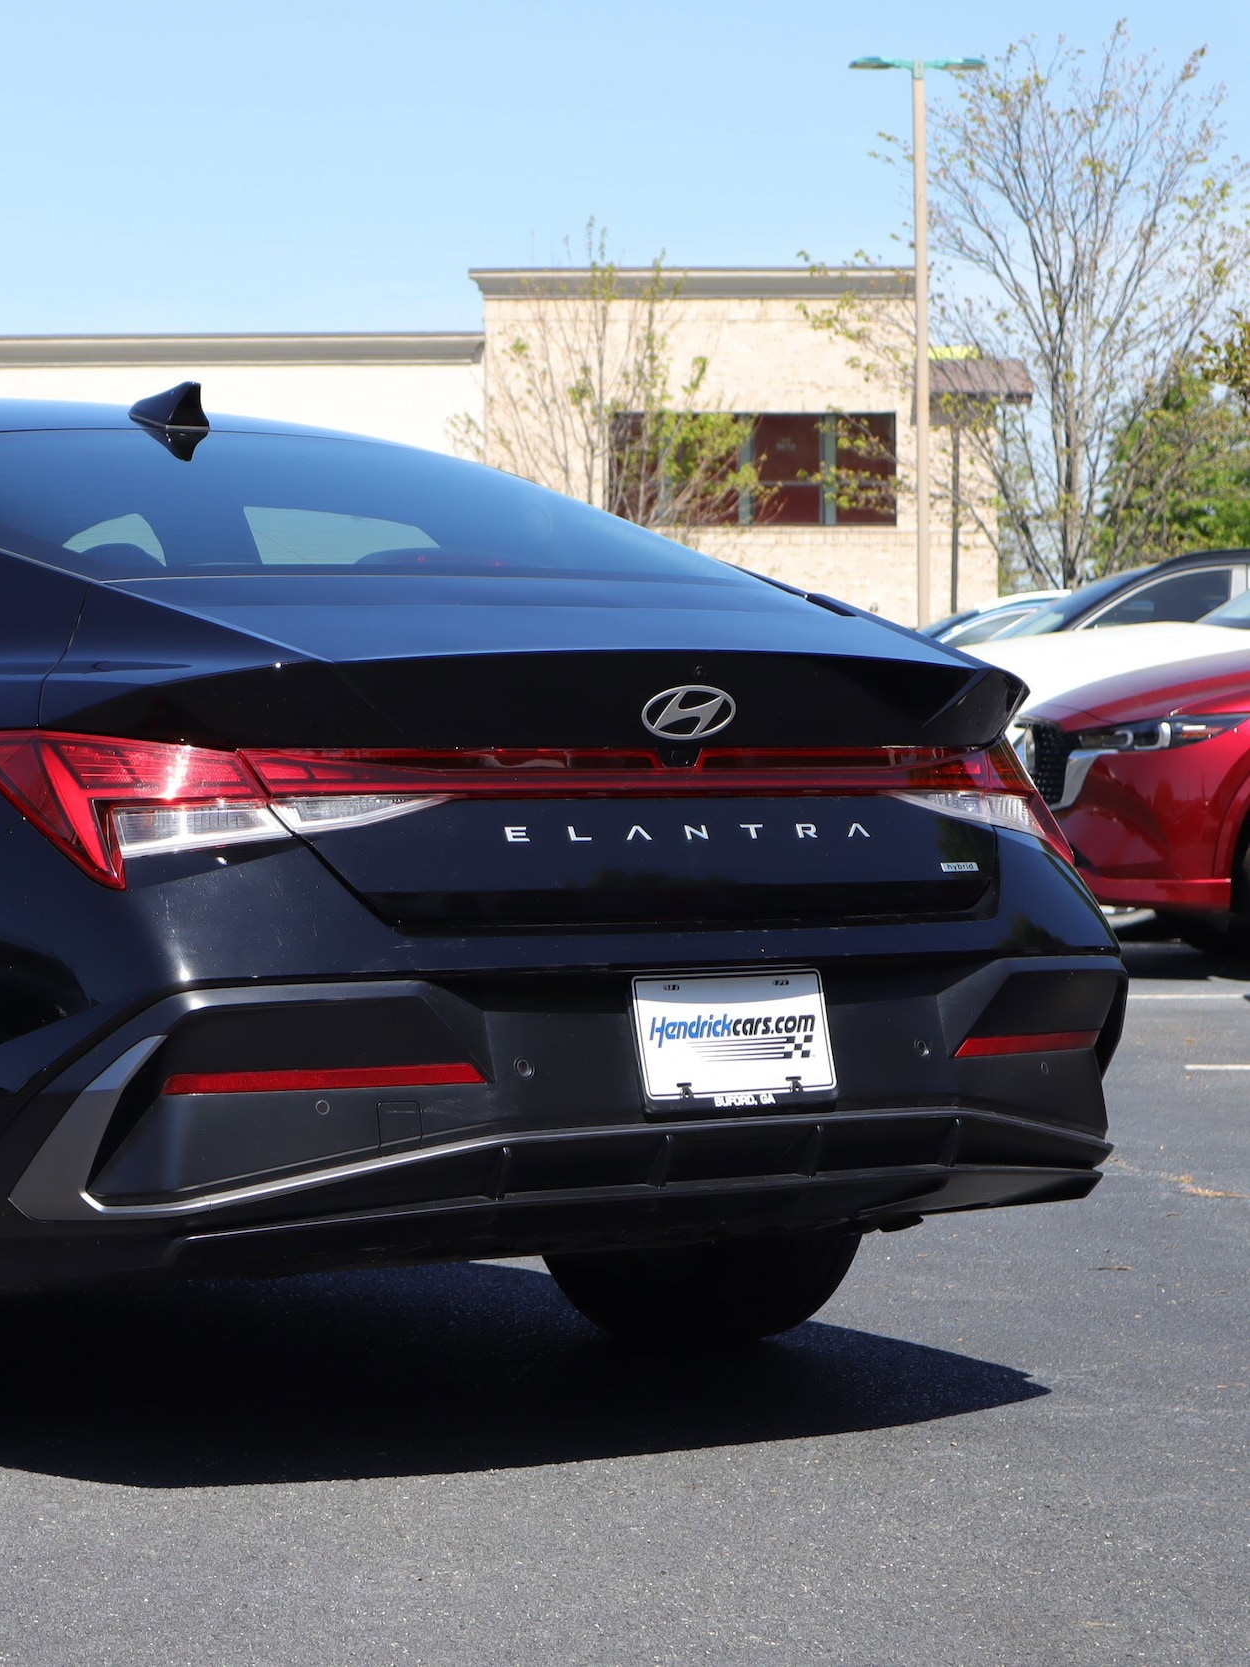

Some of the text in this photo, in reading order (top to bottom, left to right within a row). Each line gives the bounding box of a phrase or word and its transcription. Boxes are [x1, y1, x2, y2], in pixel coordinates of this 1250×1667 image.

[503, 822, 871, 843] ELANTRA
[946, 863, 974, 871] hybrid
[649, 1013, 816, 1048] Hendrickcars.com
[713, 1093, 777, 1108] BUFORD, GA
